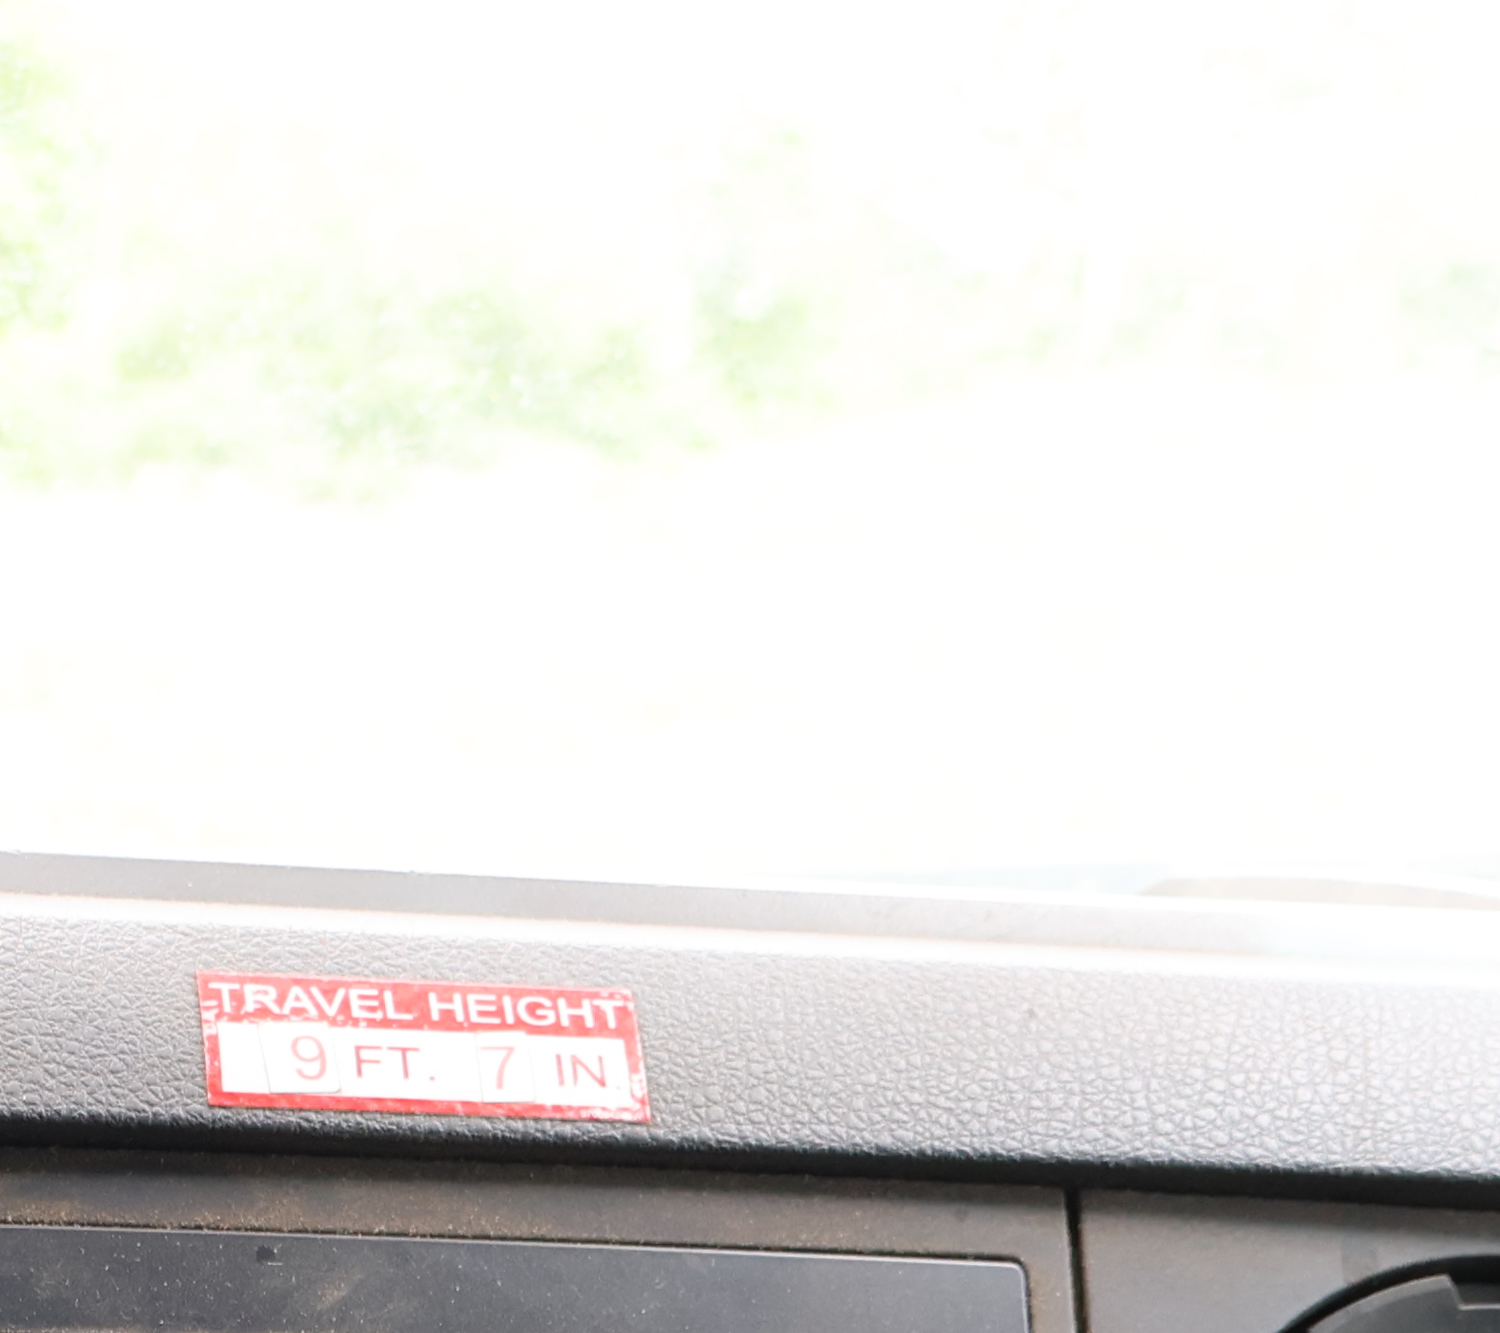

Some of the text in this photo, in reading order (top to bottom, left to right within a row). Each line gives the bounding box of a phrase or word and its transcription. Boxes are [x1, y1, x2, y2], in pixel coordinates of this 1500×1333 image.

[208, 982, 624, 1028] TRAVEL HEIGHT
[290, 1036, 327, 1081] 9
[354, 1045, 435, 1082] FT.
[478, 1046, 514, 1089] 7
